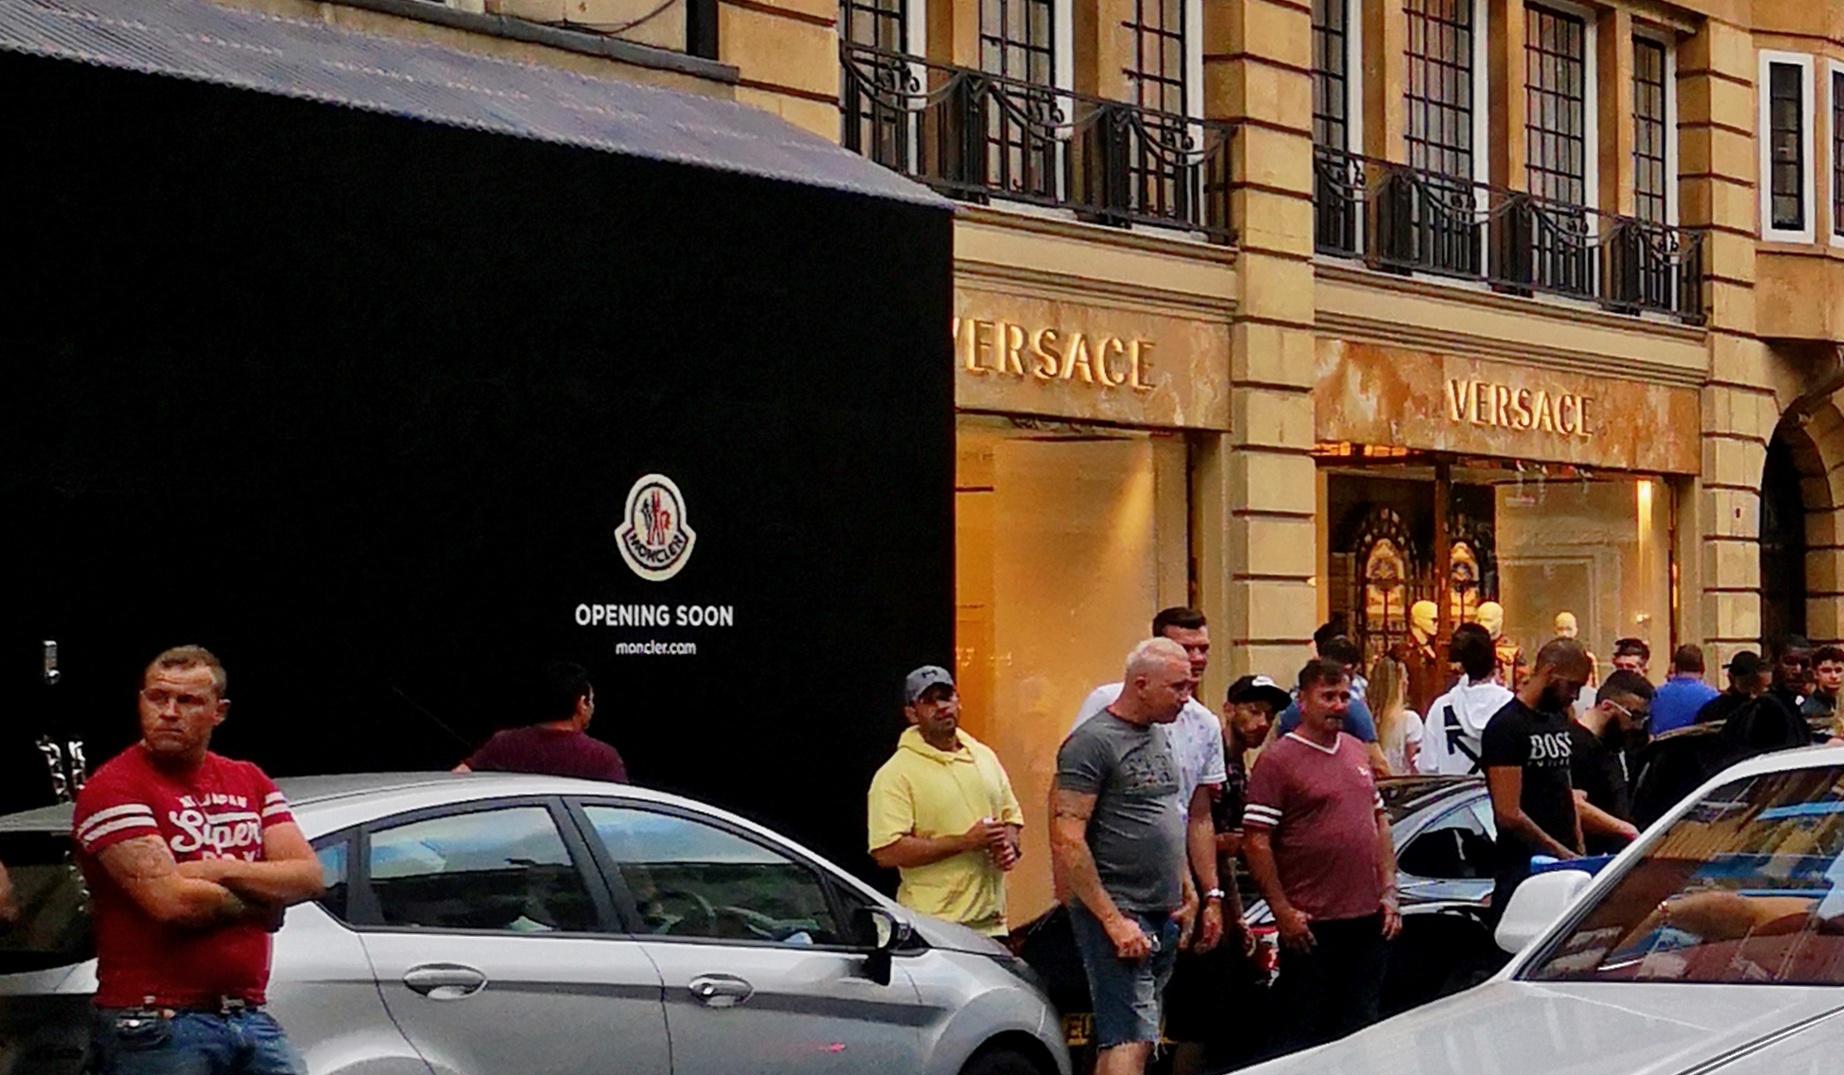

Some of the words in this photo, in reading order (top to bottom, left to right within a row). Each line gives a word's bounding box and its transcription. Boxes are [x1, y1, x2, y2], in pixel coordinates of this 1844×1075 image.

[1448, 378, 1596, 438] VERSACE
[575, 604, 670, 626] OPENING
[676, 605, 733, 626] SOON
[616, 640, 696, 655] moncler.com
